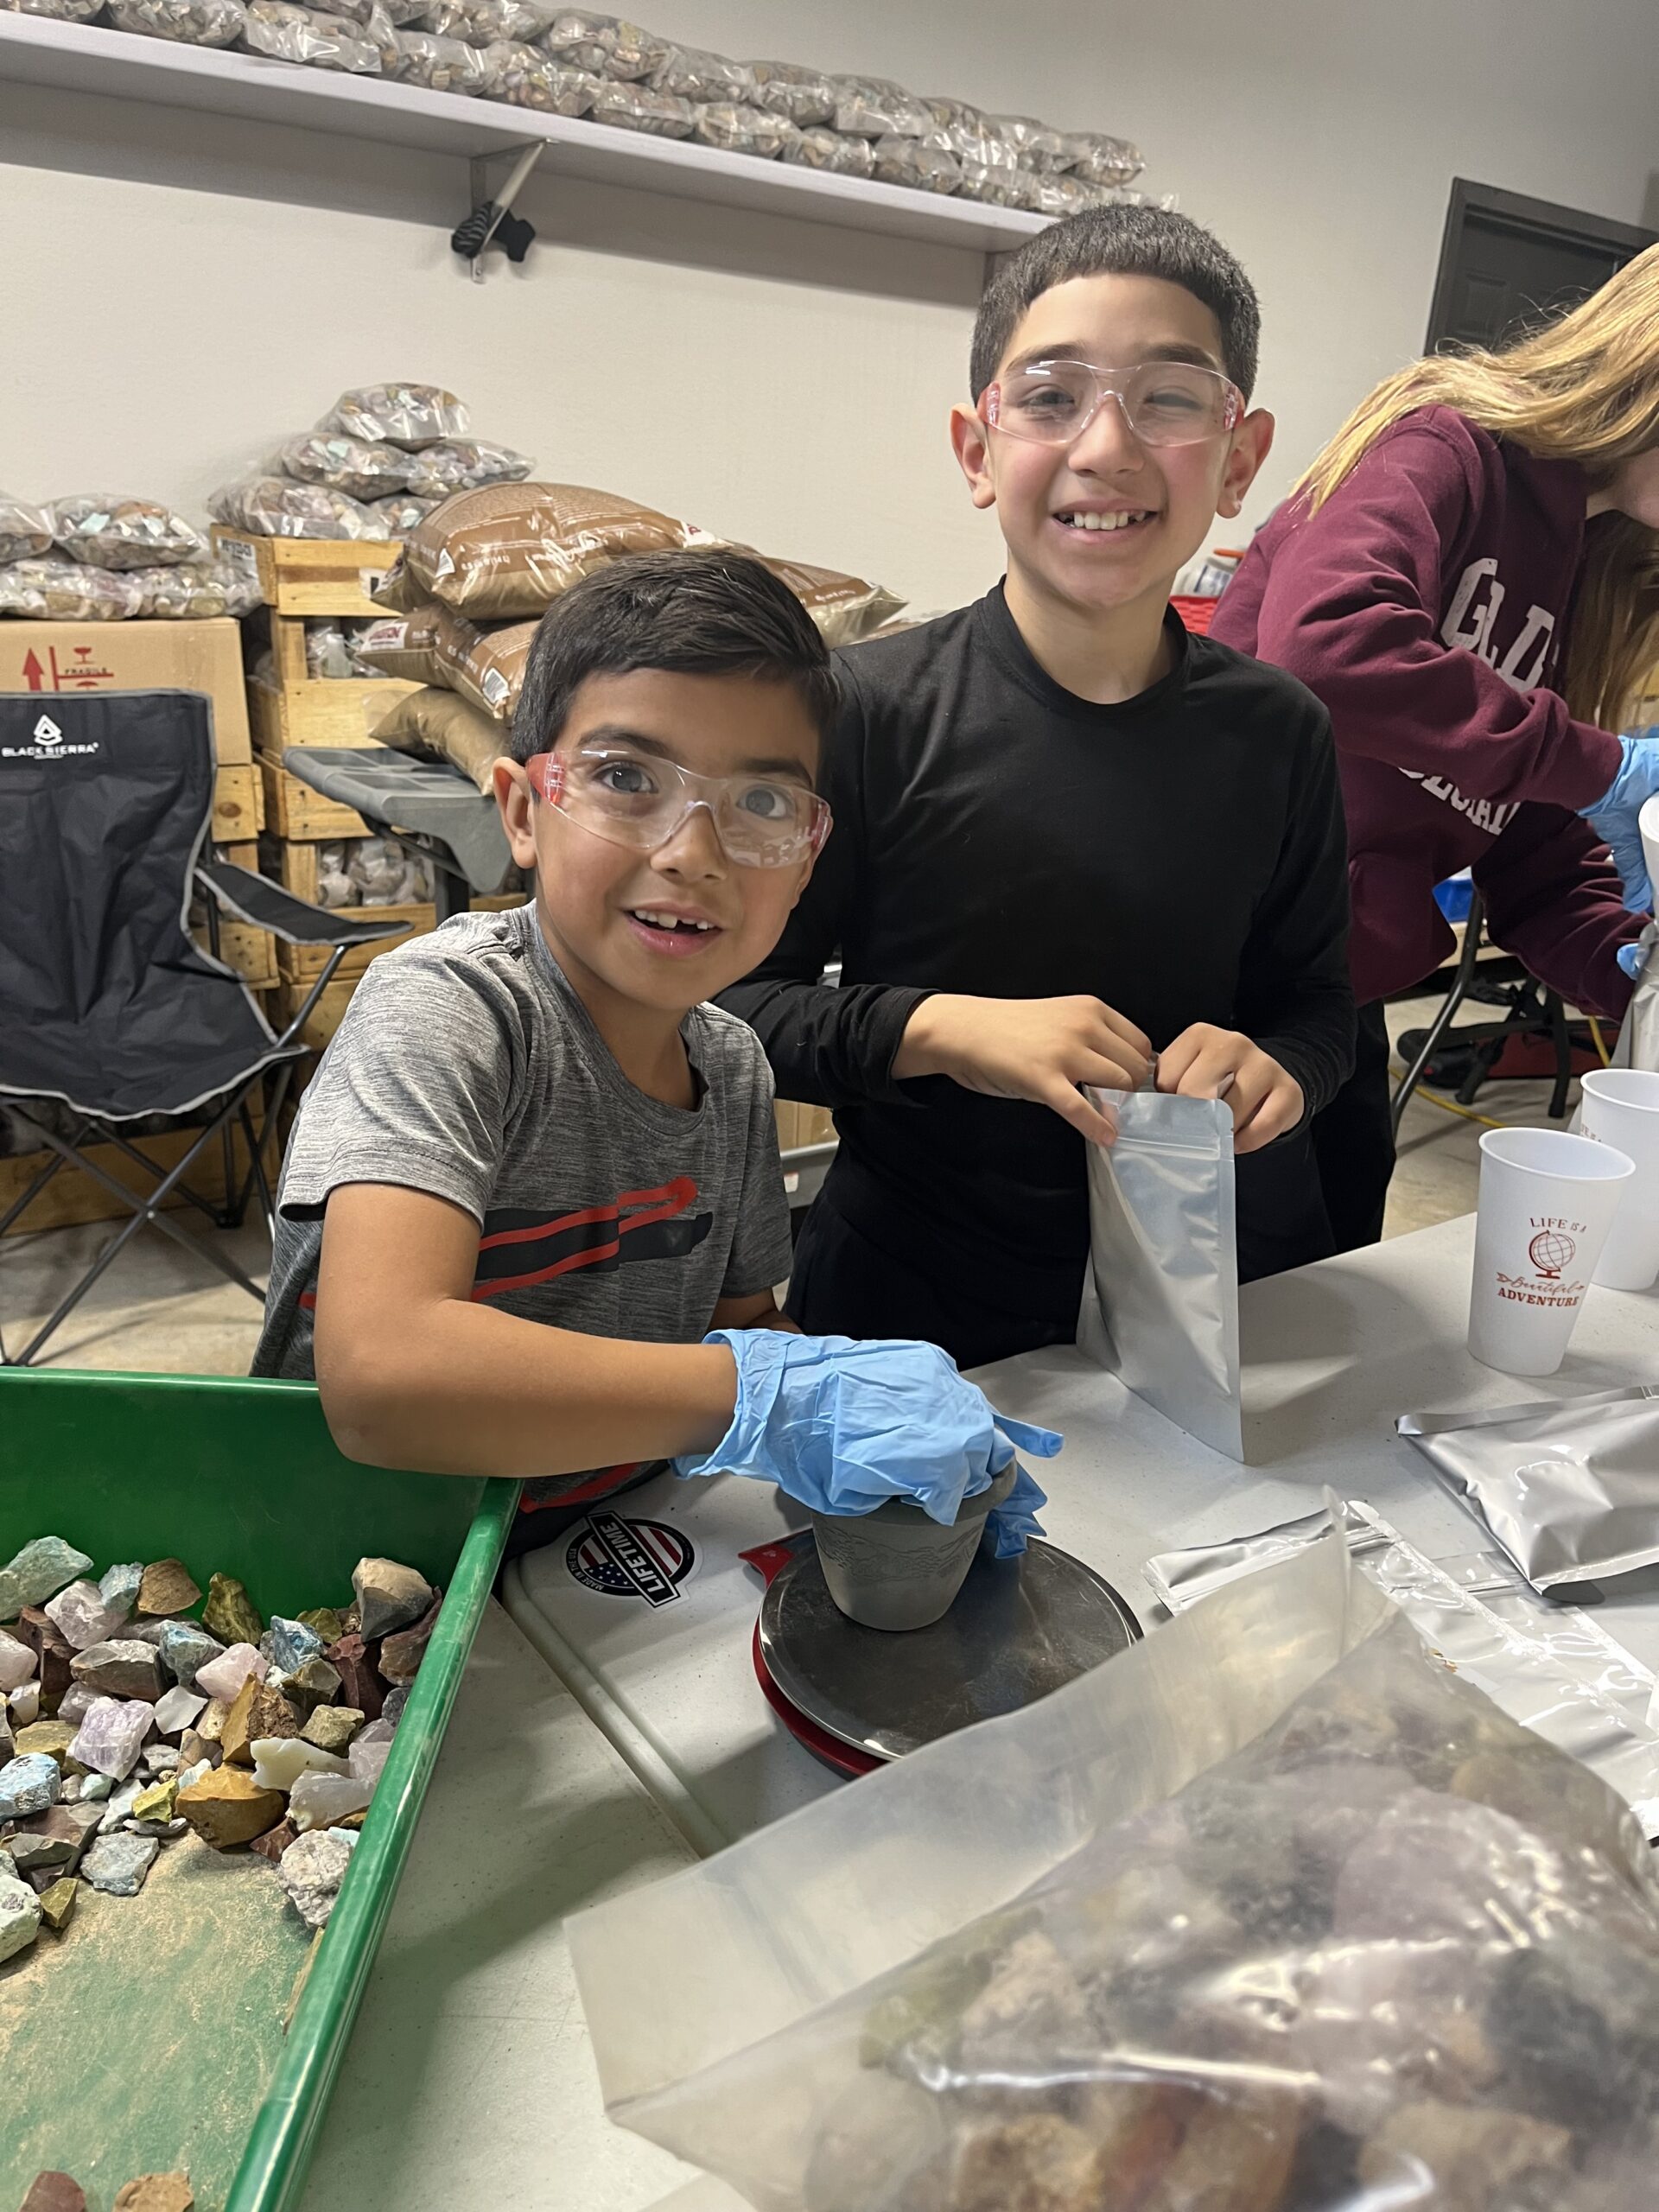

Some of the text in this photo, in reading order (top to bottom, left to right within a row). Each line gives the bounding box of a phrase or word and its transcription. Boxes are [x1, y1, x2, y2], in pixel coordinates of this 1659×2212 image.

[1529, 1217, 1568, 1229] LIFE
[1498, 1287, 1580, 1306] ADVENTURE
[600, 1522, 665, 1592] LIFETIME
[568, 1559, 580, 1572] THE
[582, 1577, 605, 1591] MADE
